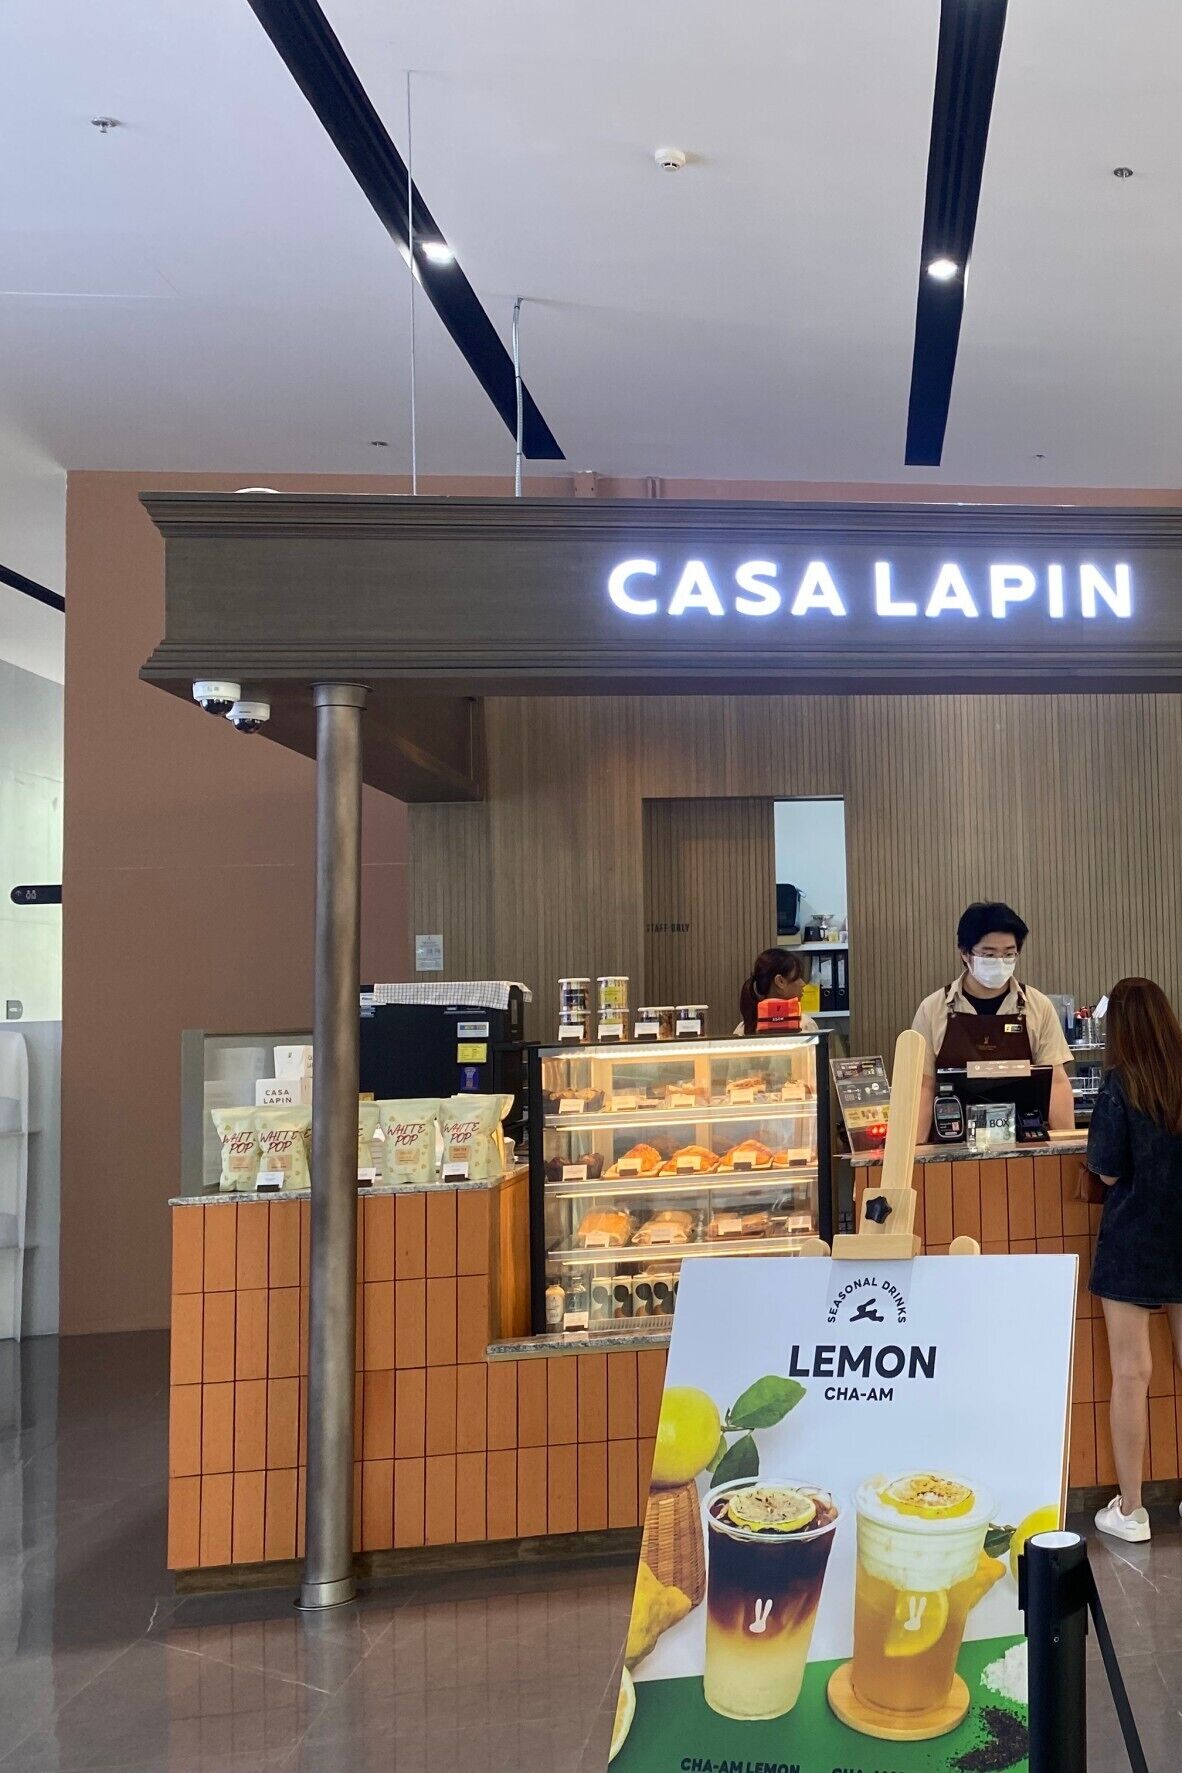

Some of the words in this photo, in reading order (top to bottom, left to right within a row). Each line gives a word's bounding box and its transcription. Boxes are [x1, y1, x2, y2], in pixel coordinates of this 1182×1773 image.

[607, 559, 847, 616] CASA
[874, 561, 1132, 619] LAPIN
[387, 1123, 426, 1136] WHITE
[443, 1121, 480, 1133] WHITE
[989, 1118, 1010, 1129] BOX
[223, 1131, 256, 1144] WHIT
[394, 1134, 419, 1146] POP
[450, 1132, 472, 1144] POP
[229, 1142, 254, 1154] POP
[267, 1141, 293, 1153] POP
[827, 1277, 878, 1323] SEASONAL
[881, 1280, 906, 1323] DRINKS
[788, 1345, 937, 1379] LEMON
[824, 1387, 894, 1401] CHA-AM
[681, 1757, 743, 1773] CHA-AM
[746, 1761, 801, 1773] LEMON
